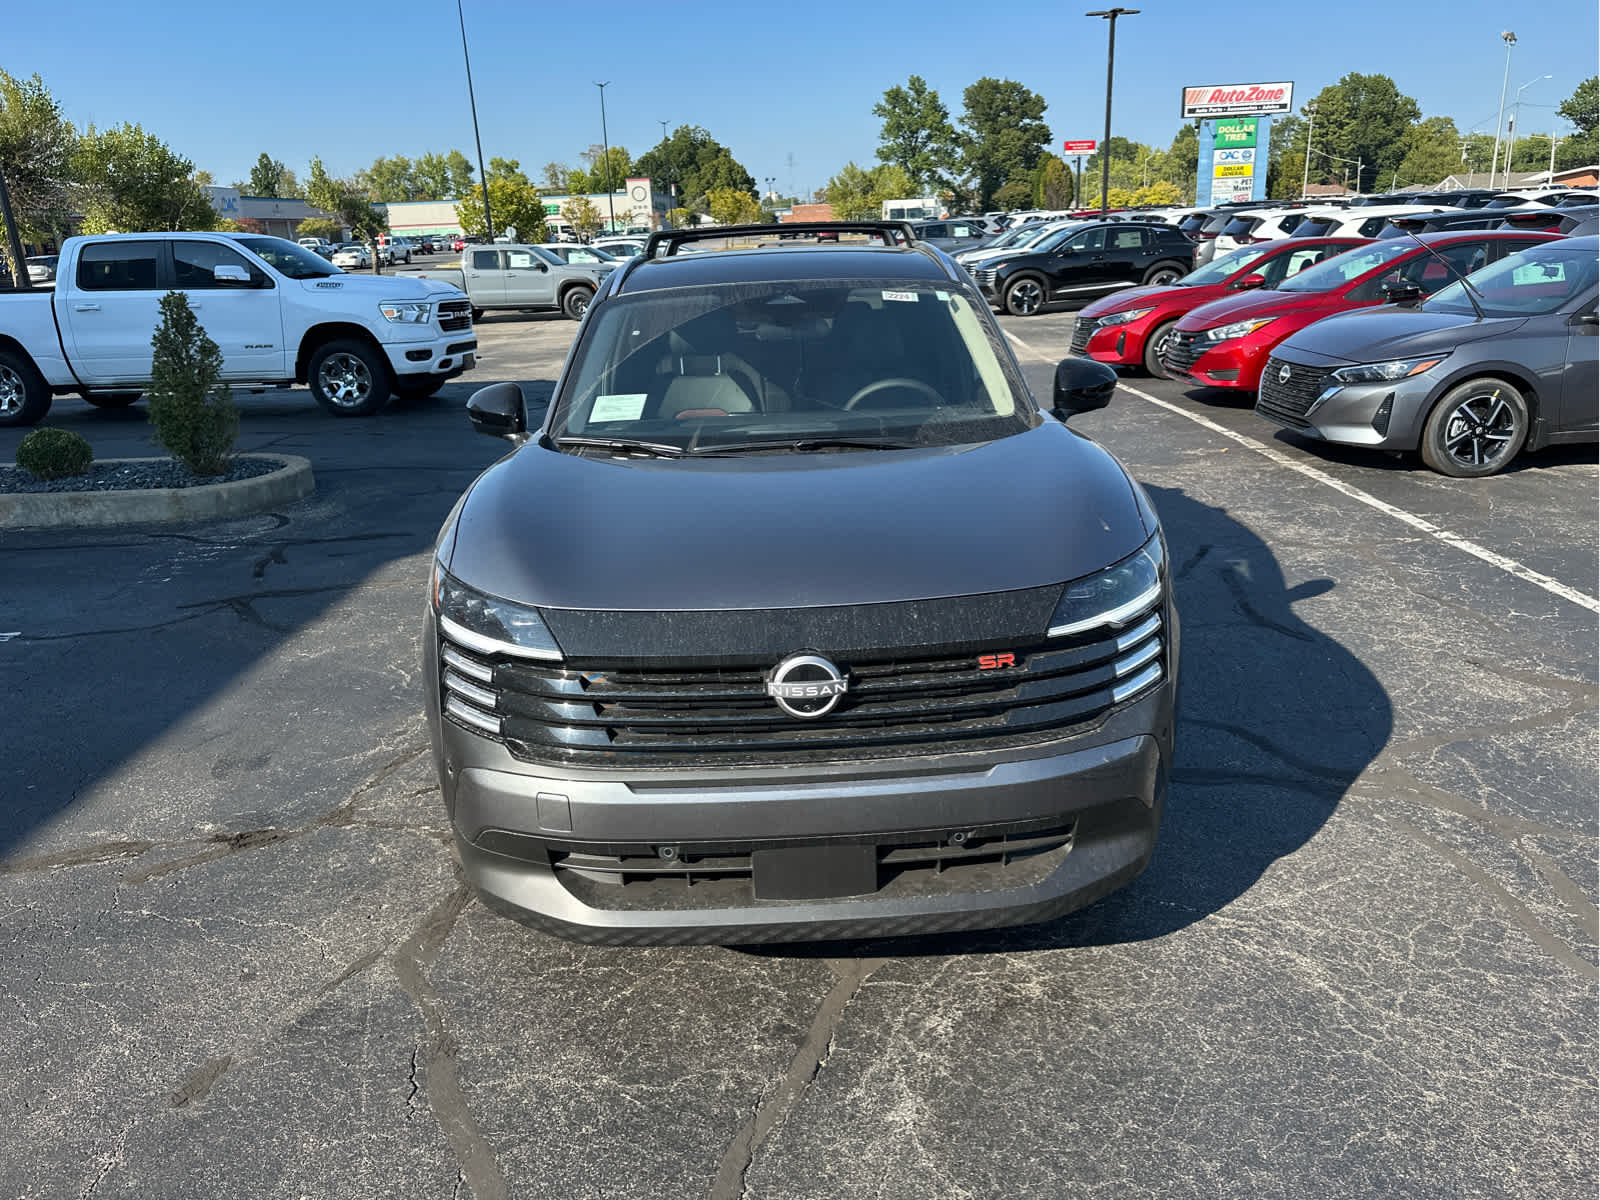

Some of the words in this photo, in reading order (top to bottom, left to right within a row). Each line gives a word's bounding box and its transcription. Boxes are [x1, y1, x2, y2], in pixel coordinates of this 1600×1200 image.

[1208, 87, 1284, 104] AutoZone
[1217, 124, 1255, 134] DOLLAR
[1225, 133, 1247, 142] TREE
[978, 652, 1016, 670] SR
[768, 681, 848, 698] NISSAN
